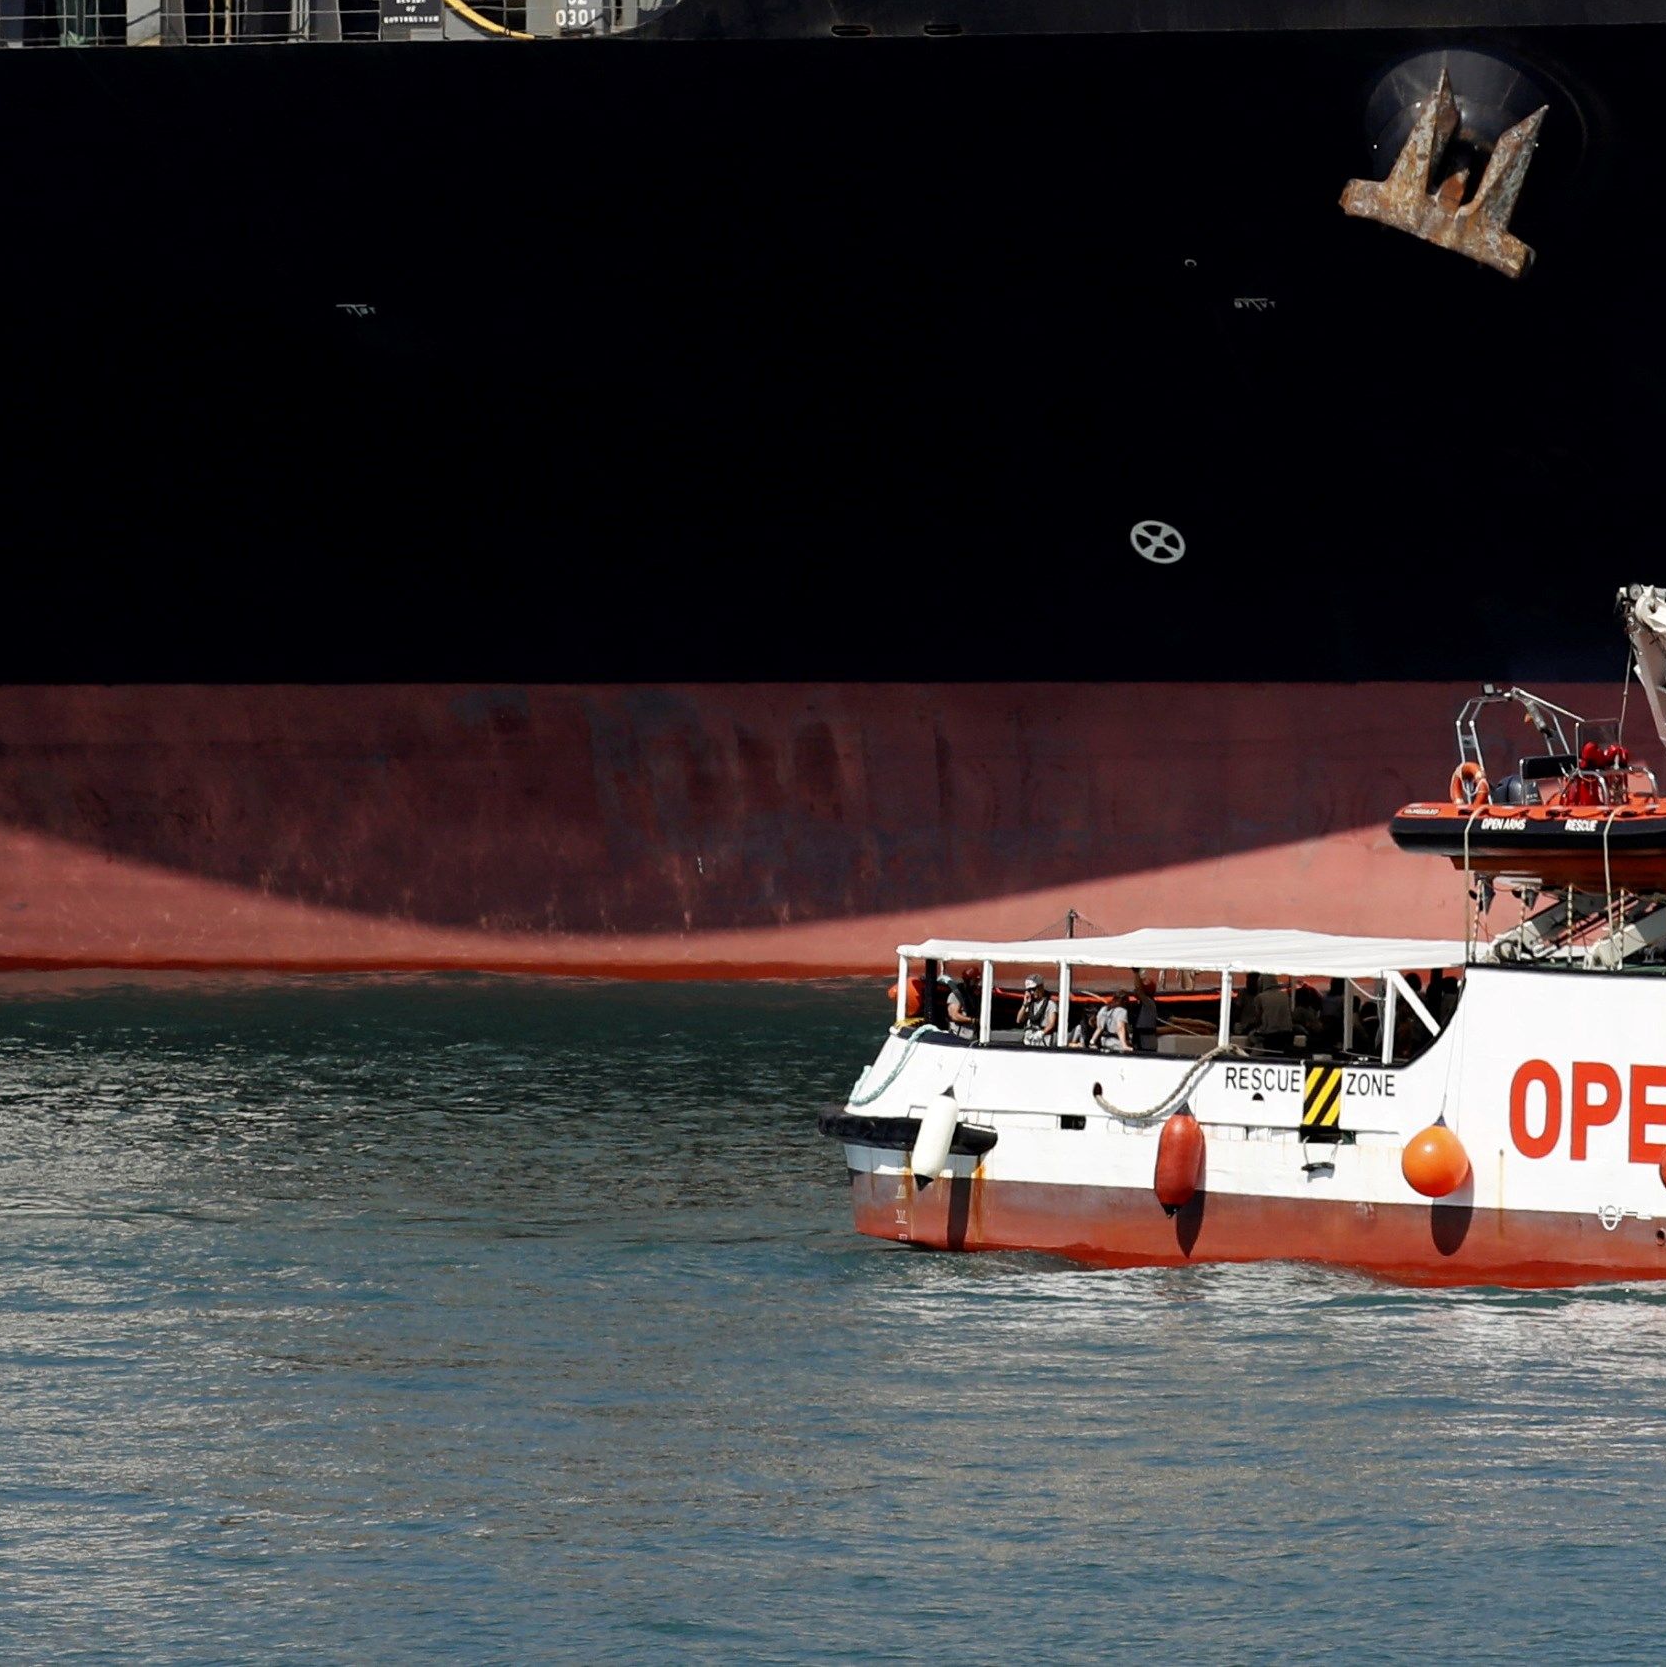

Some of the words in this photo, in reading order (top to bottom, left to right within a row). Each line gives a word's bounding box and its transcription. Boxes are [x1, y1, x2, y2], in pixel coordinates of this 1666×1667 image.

[1481, 818, 1503, 831] OPEN
[1565, 820, 1599, 832] RESCUE
[1225, 1066, 1301, 1092] RESCUE
[1345, 1073, 1396, 1097] ZONE
